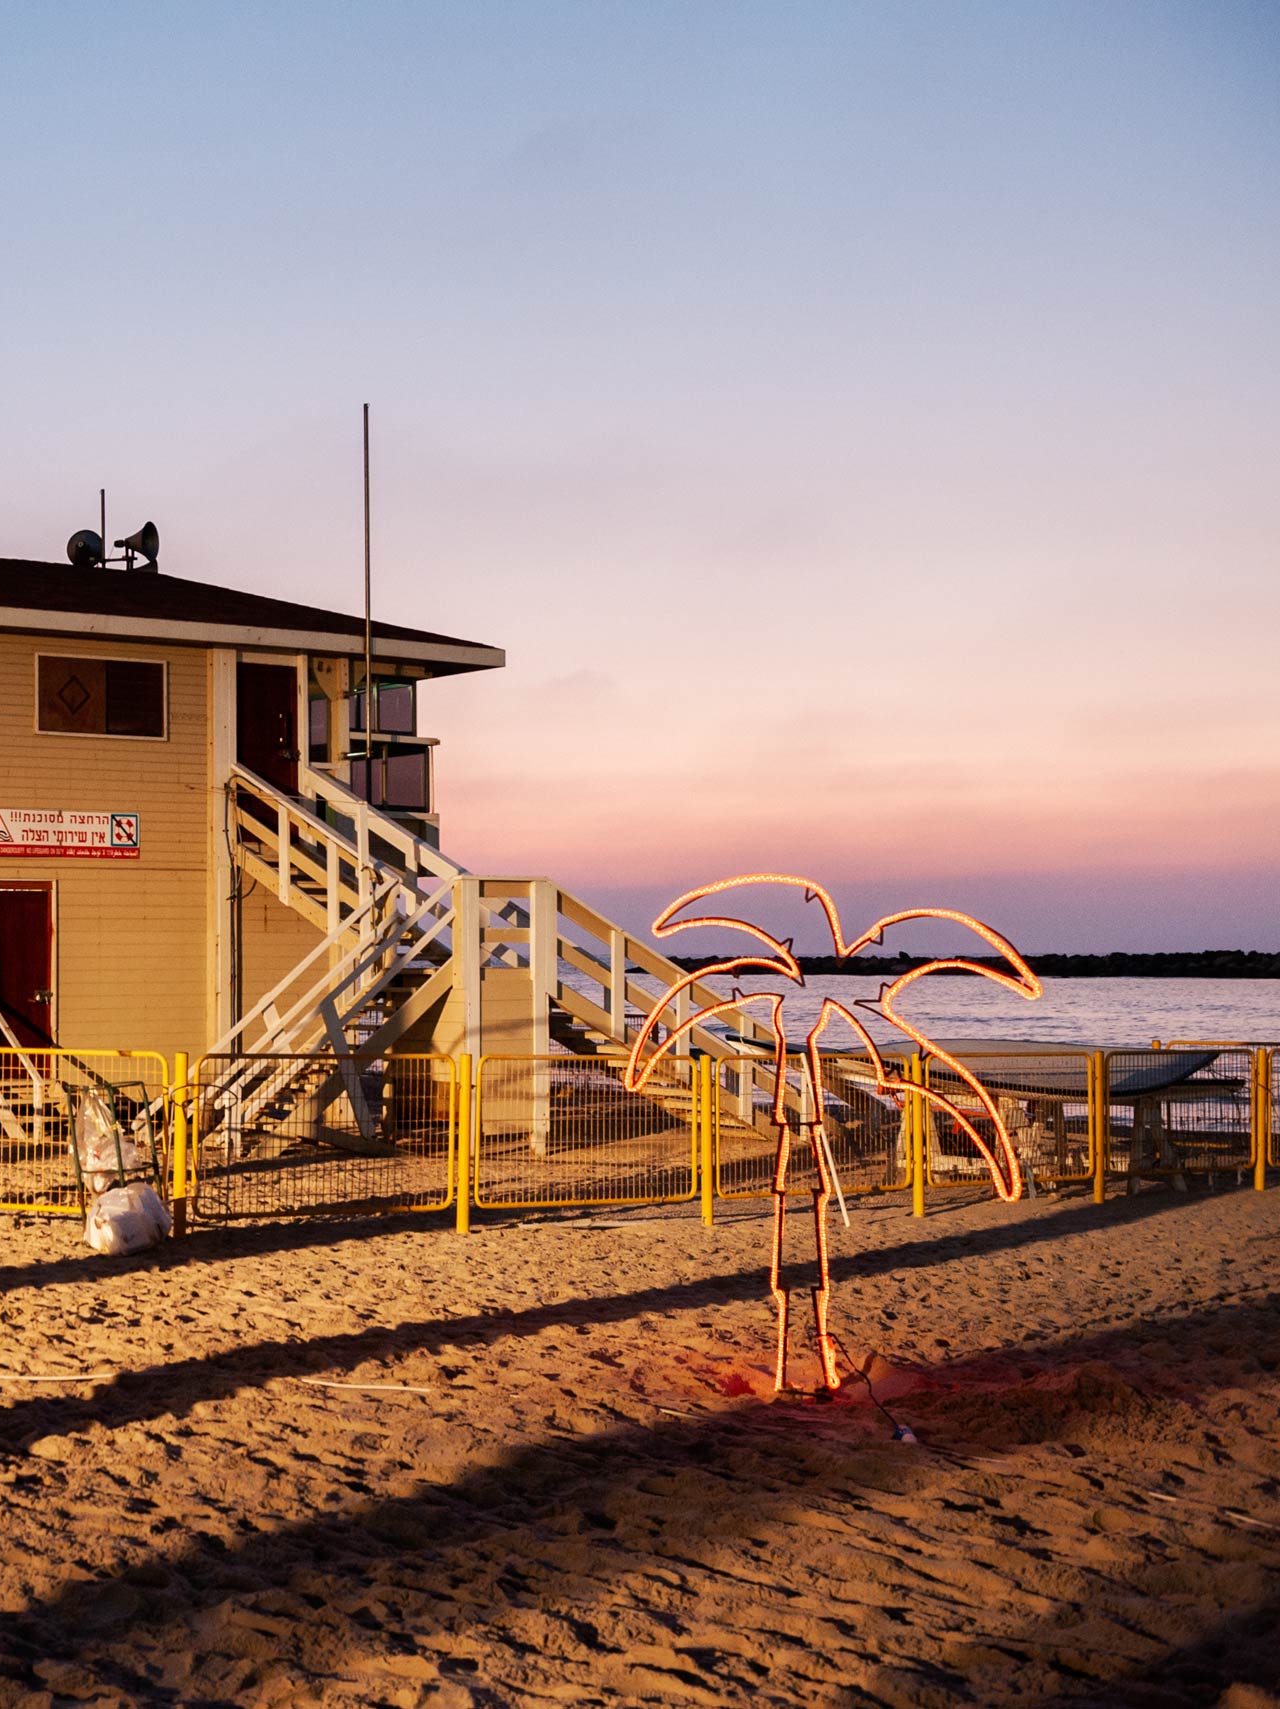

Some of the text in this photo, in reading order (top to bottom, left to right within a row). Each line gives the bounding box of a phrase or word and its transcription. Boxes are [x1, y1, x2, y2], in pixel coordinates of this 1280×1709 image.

[10, 811, 110, 825] הרחצה מסוכנת!!!
[21, 828, 106, 845] אין שירותי הצלה
